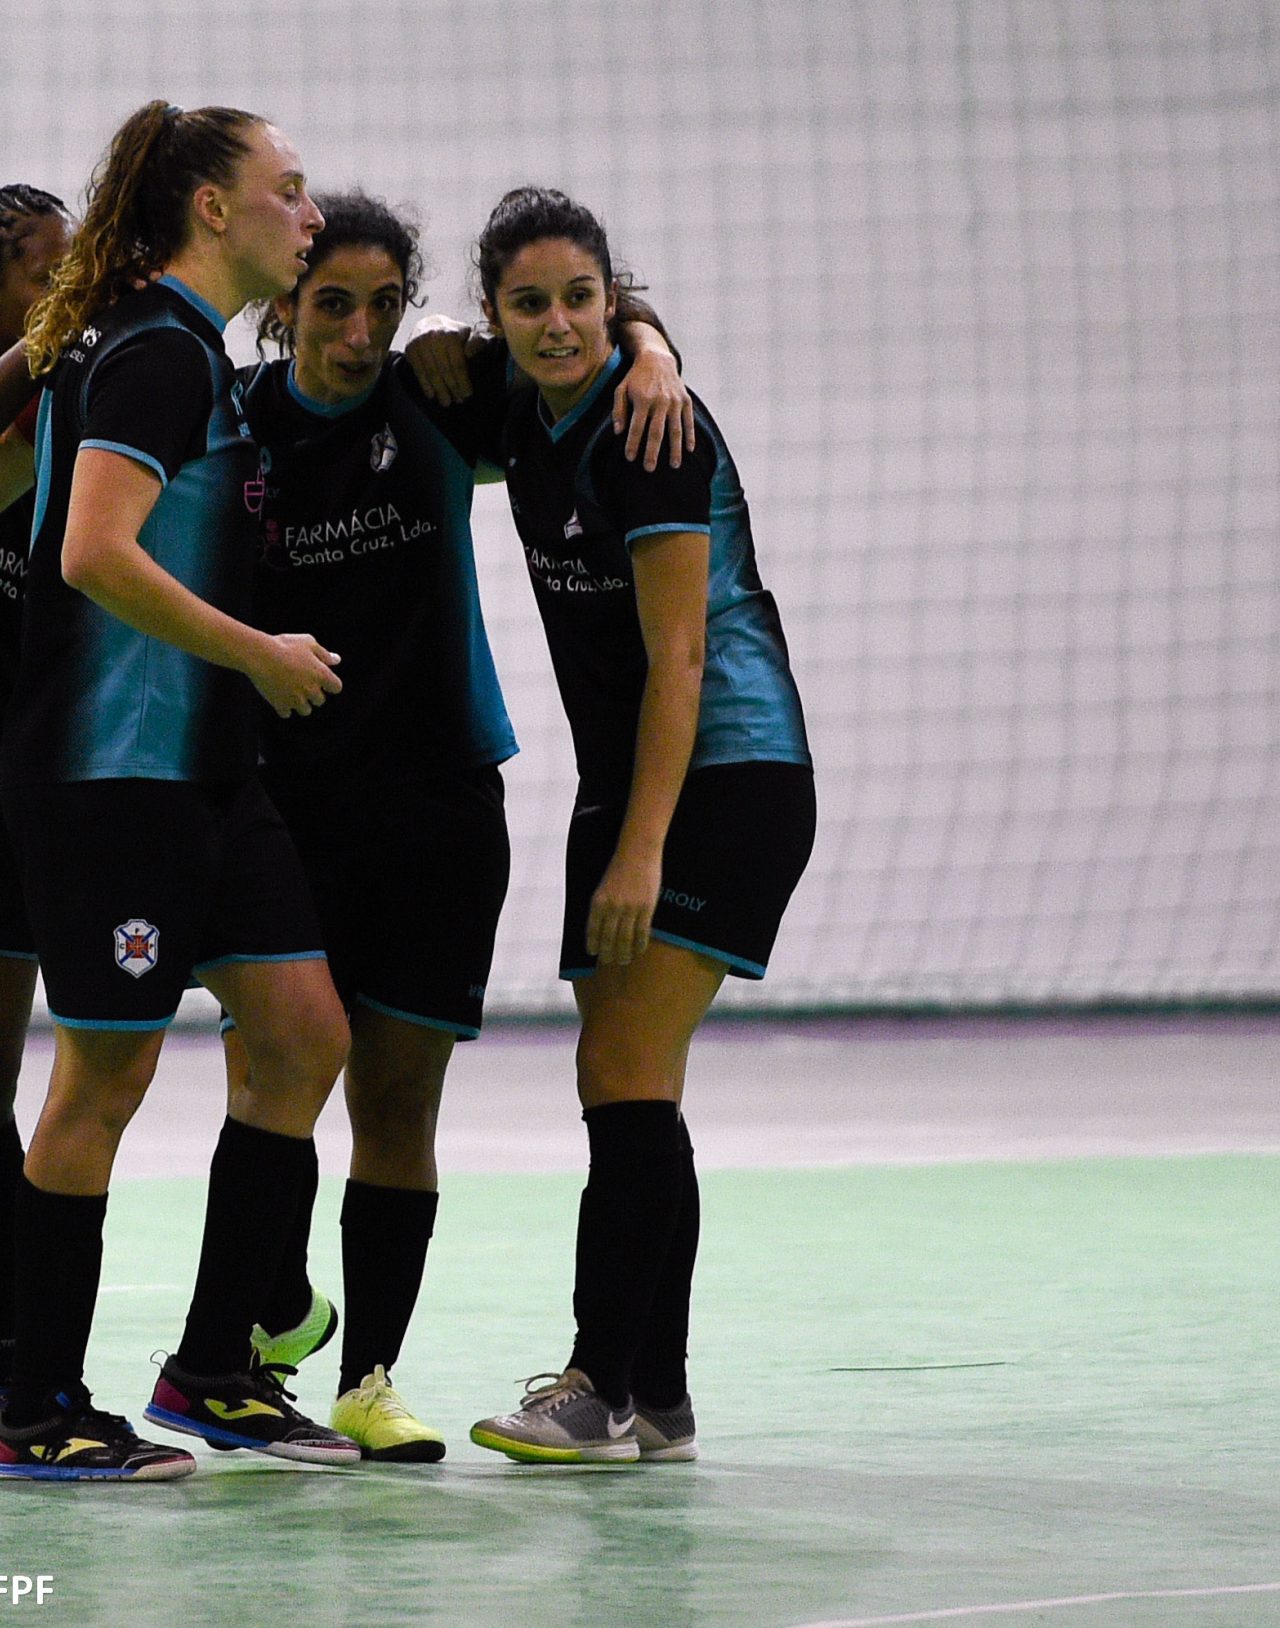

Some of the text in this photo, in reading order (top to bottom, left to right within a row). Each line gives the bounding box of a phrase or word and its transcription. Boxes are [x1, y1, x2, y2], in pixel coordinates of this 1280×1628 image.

[285, 502, 402, 548] FARMÁCIA
[289, 519, 438, 567] Santa Cruz, Lda.
[663, 887, 707, 912] ROLY
